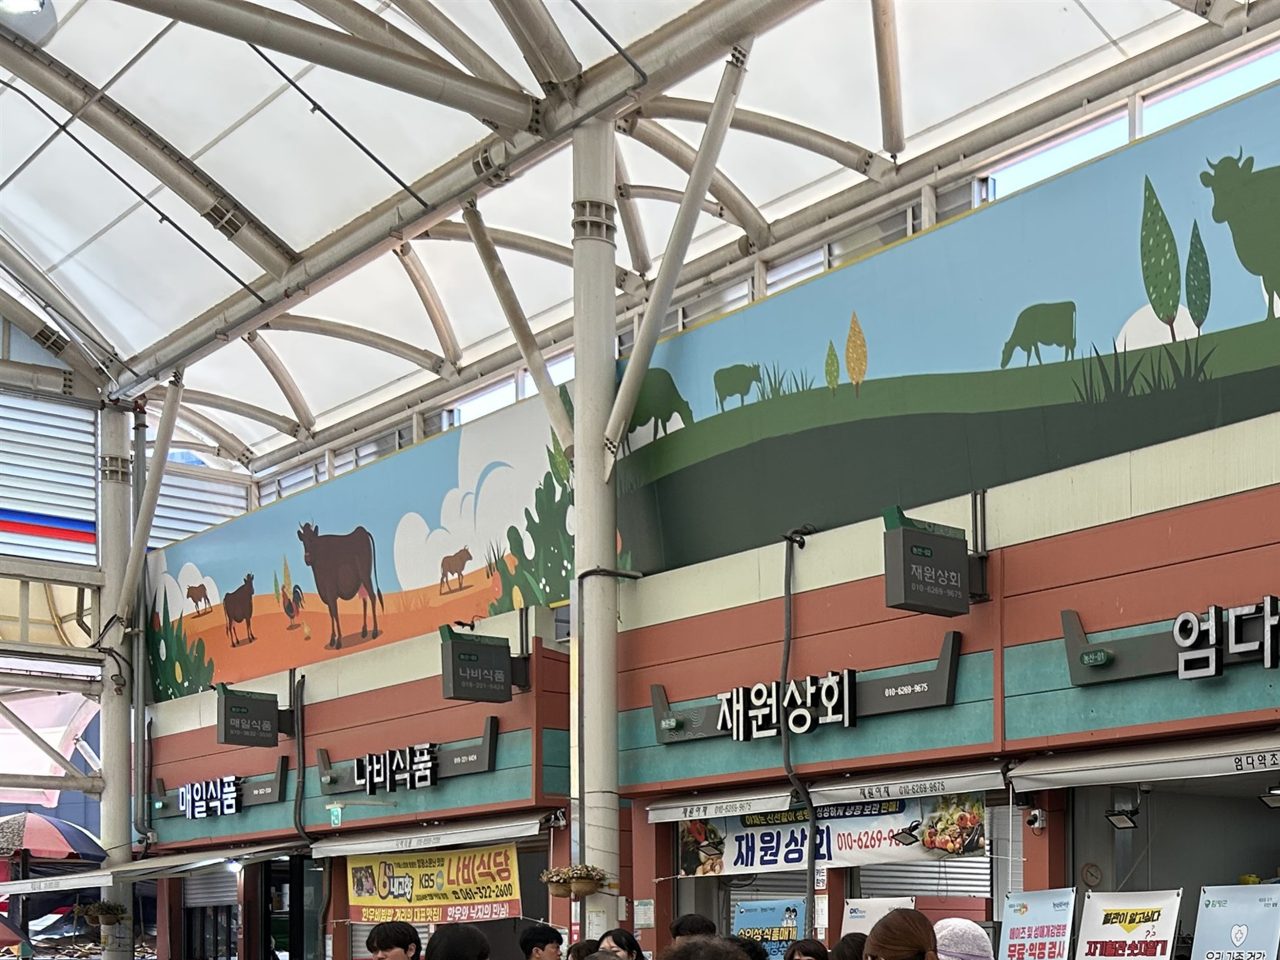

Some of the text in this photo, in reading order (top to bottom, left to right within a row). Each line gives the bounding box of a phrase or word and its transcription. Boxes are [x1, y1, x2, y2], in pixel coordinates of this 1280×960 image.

[911, 564, 961, 587] 재원상회
[459, 667, 504, 682] 나비식품
[885, 683, 929, 697] 010-6269-9675
[716, 669, 852, 741] 재원상회
[230, 718, 272, 731] 매일식품
[354, 743, 433, 795] 나비식품
[1234, 753, 1279, 771] 염다약초
[179, 775, 237, 820] 매일식품
[863, 803, 880, 815] 보관
[733, 825, 904, 867] 재원상회 010-6269-96
[447, 849, 511, 886] 나비식당
[419, 873, 435, 889] KBS
[460, 883, 513, 900] 061-322-2600
[447, 905, 469, 920] 한우와
[492, 902, 509, 918] 만남!
[1102, 911, 1128, 925] 혈관이
[1048, 940, 1066, 959] 검사
